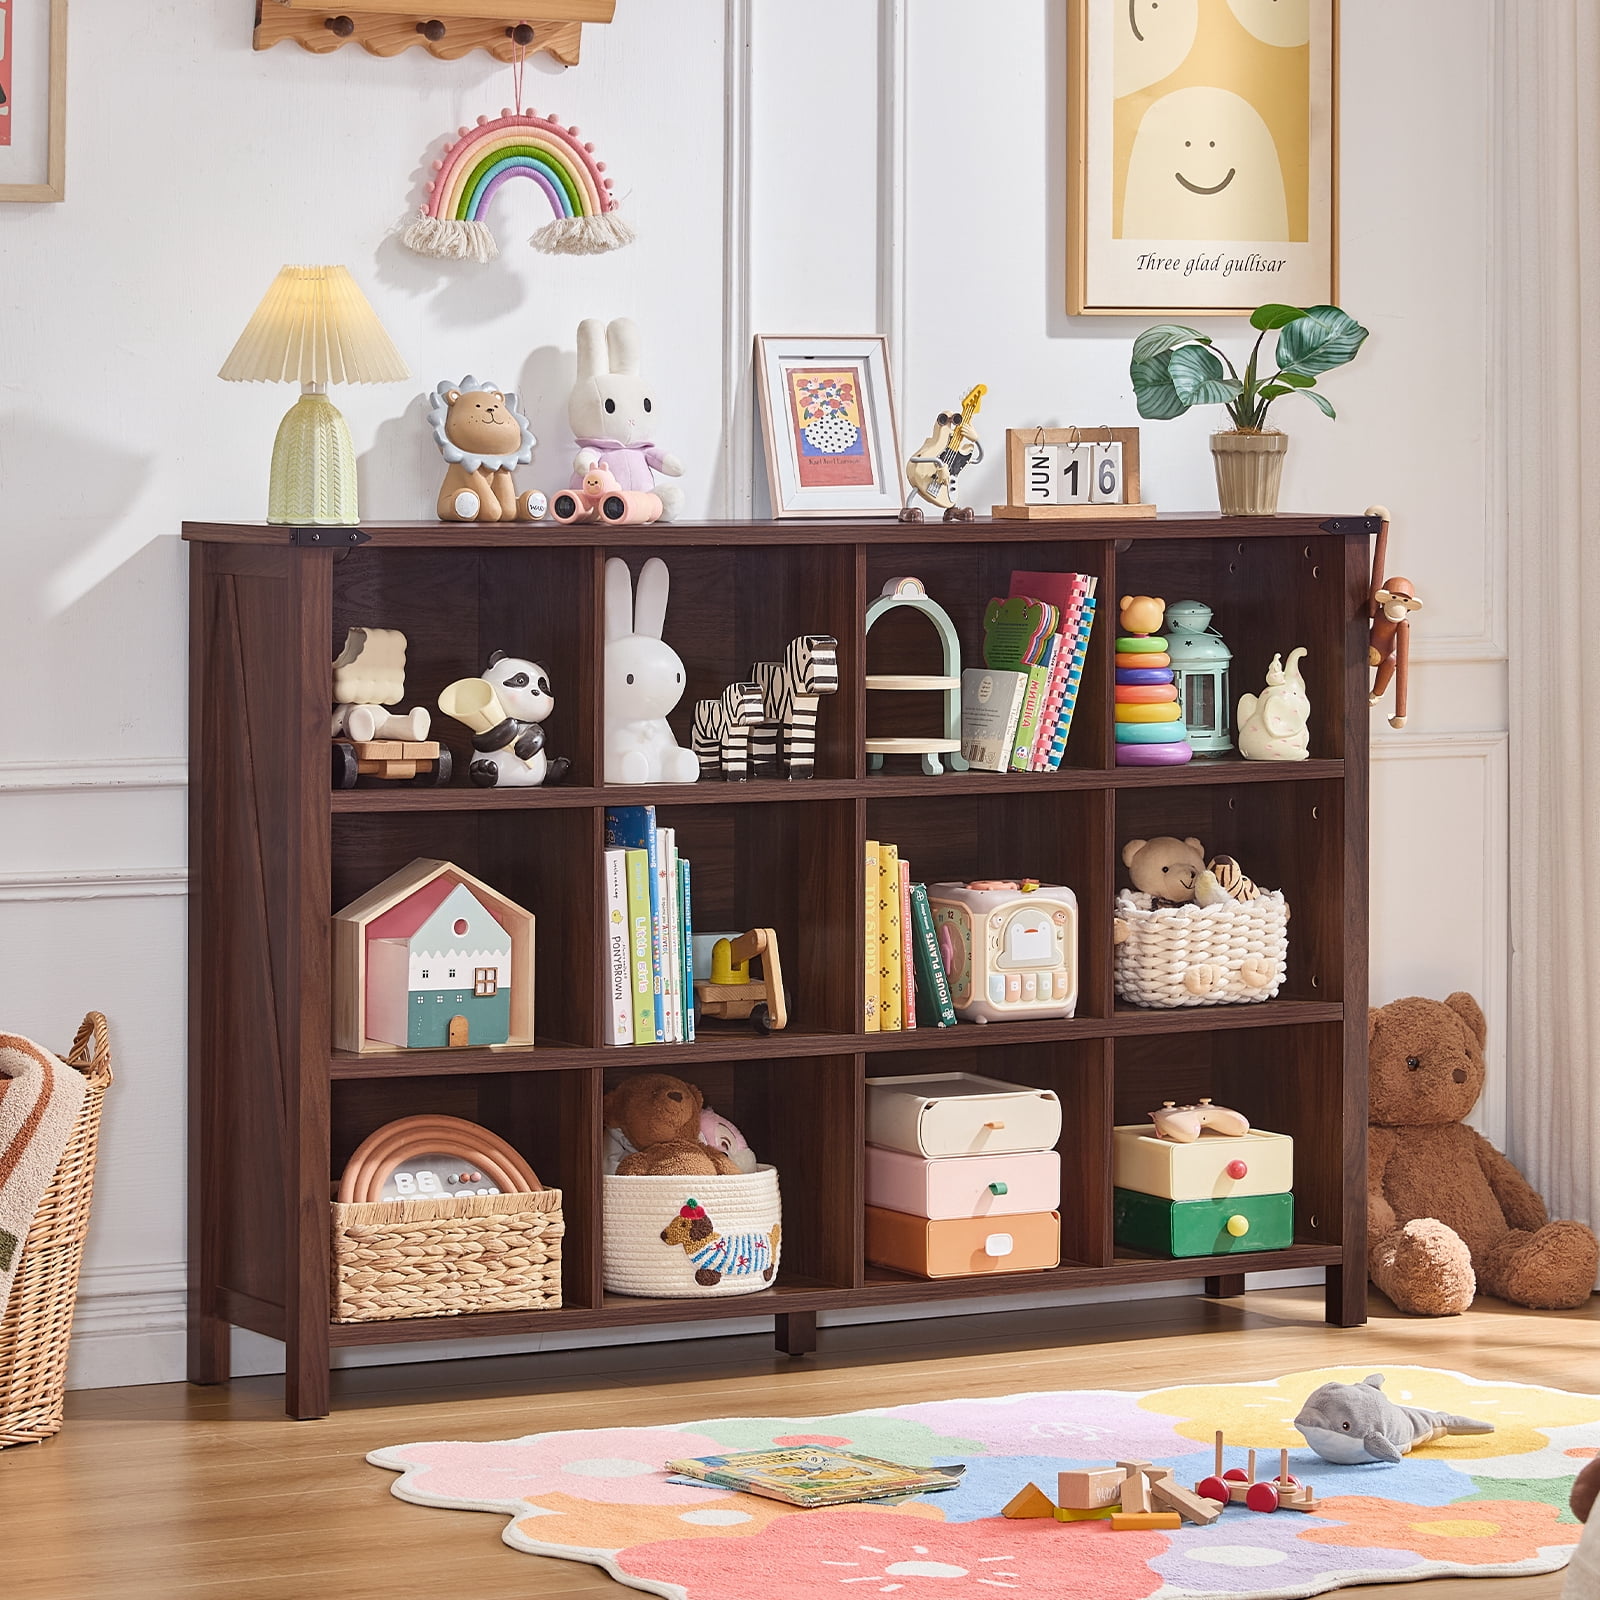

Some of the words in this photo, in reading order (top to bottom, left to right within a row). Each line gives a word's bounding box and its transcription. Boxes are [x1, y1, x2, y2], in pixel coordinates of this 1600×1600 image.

[1136, 252, 1181, 271] Three
[1183, 253, 1225, 277] glad
[1222, 253, 1287, 278] gullisar
[1031, 456, 1050, 498] JUN
[1063, 460, 1079, 496] 1
[1098, 459, 1116, 495] 6
[1021, 680, 1040, 728] МИШКА
[865, 884, 876, 918] TOY
[947, 910, 954, 919] 12
[635, 916, 648, 957] Little
[865, 920, 876, 977] STORY
[926, 932, 941, 970] PLANTS
[612, 935, 623, 1000] PONYBROWN
[995, 983, 1004, 992] A
[1010, 981, 1019, 992] B
[1025, 981, 1035, 991] C
[1042, 980, 1050, 990] D
[1058, 978, 1065, 989] E
[935, 971, 948, 1005] HOUSE
[394, 1170, 436, 1194] BE
